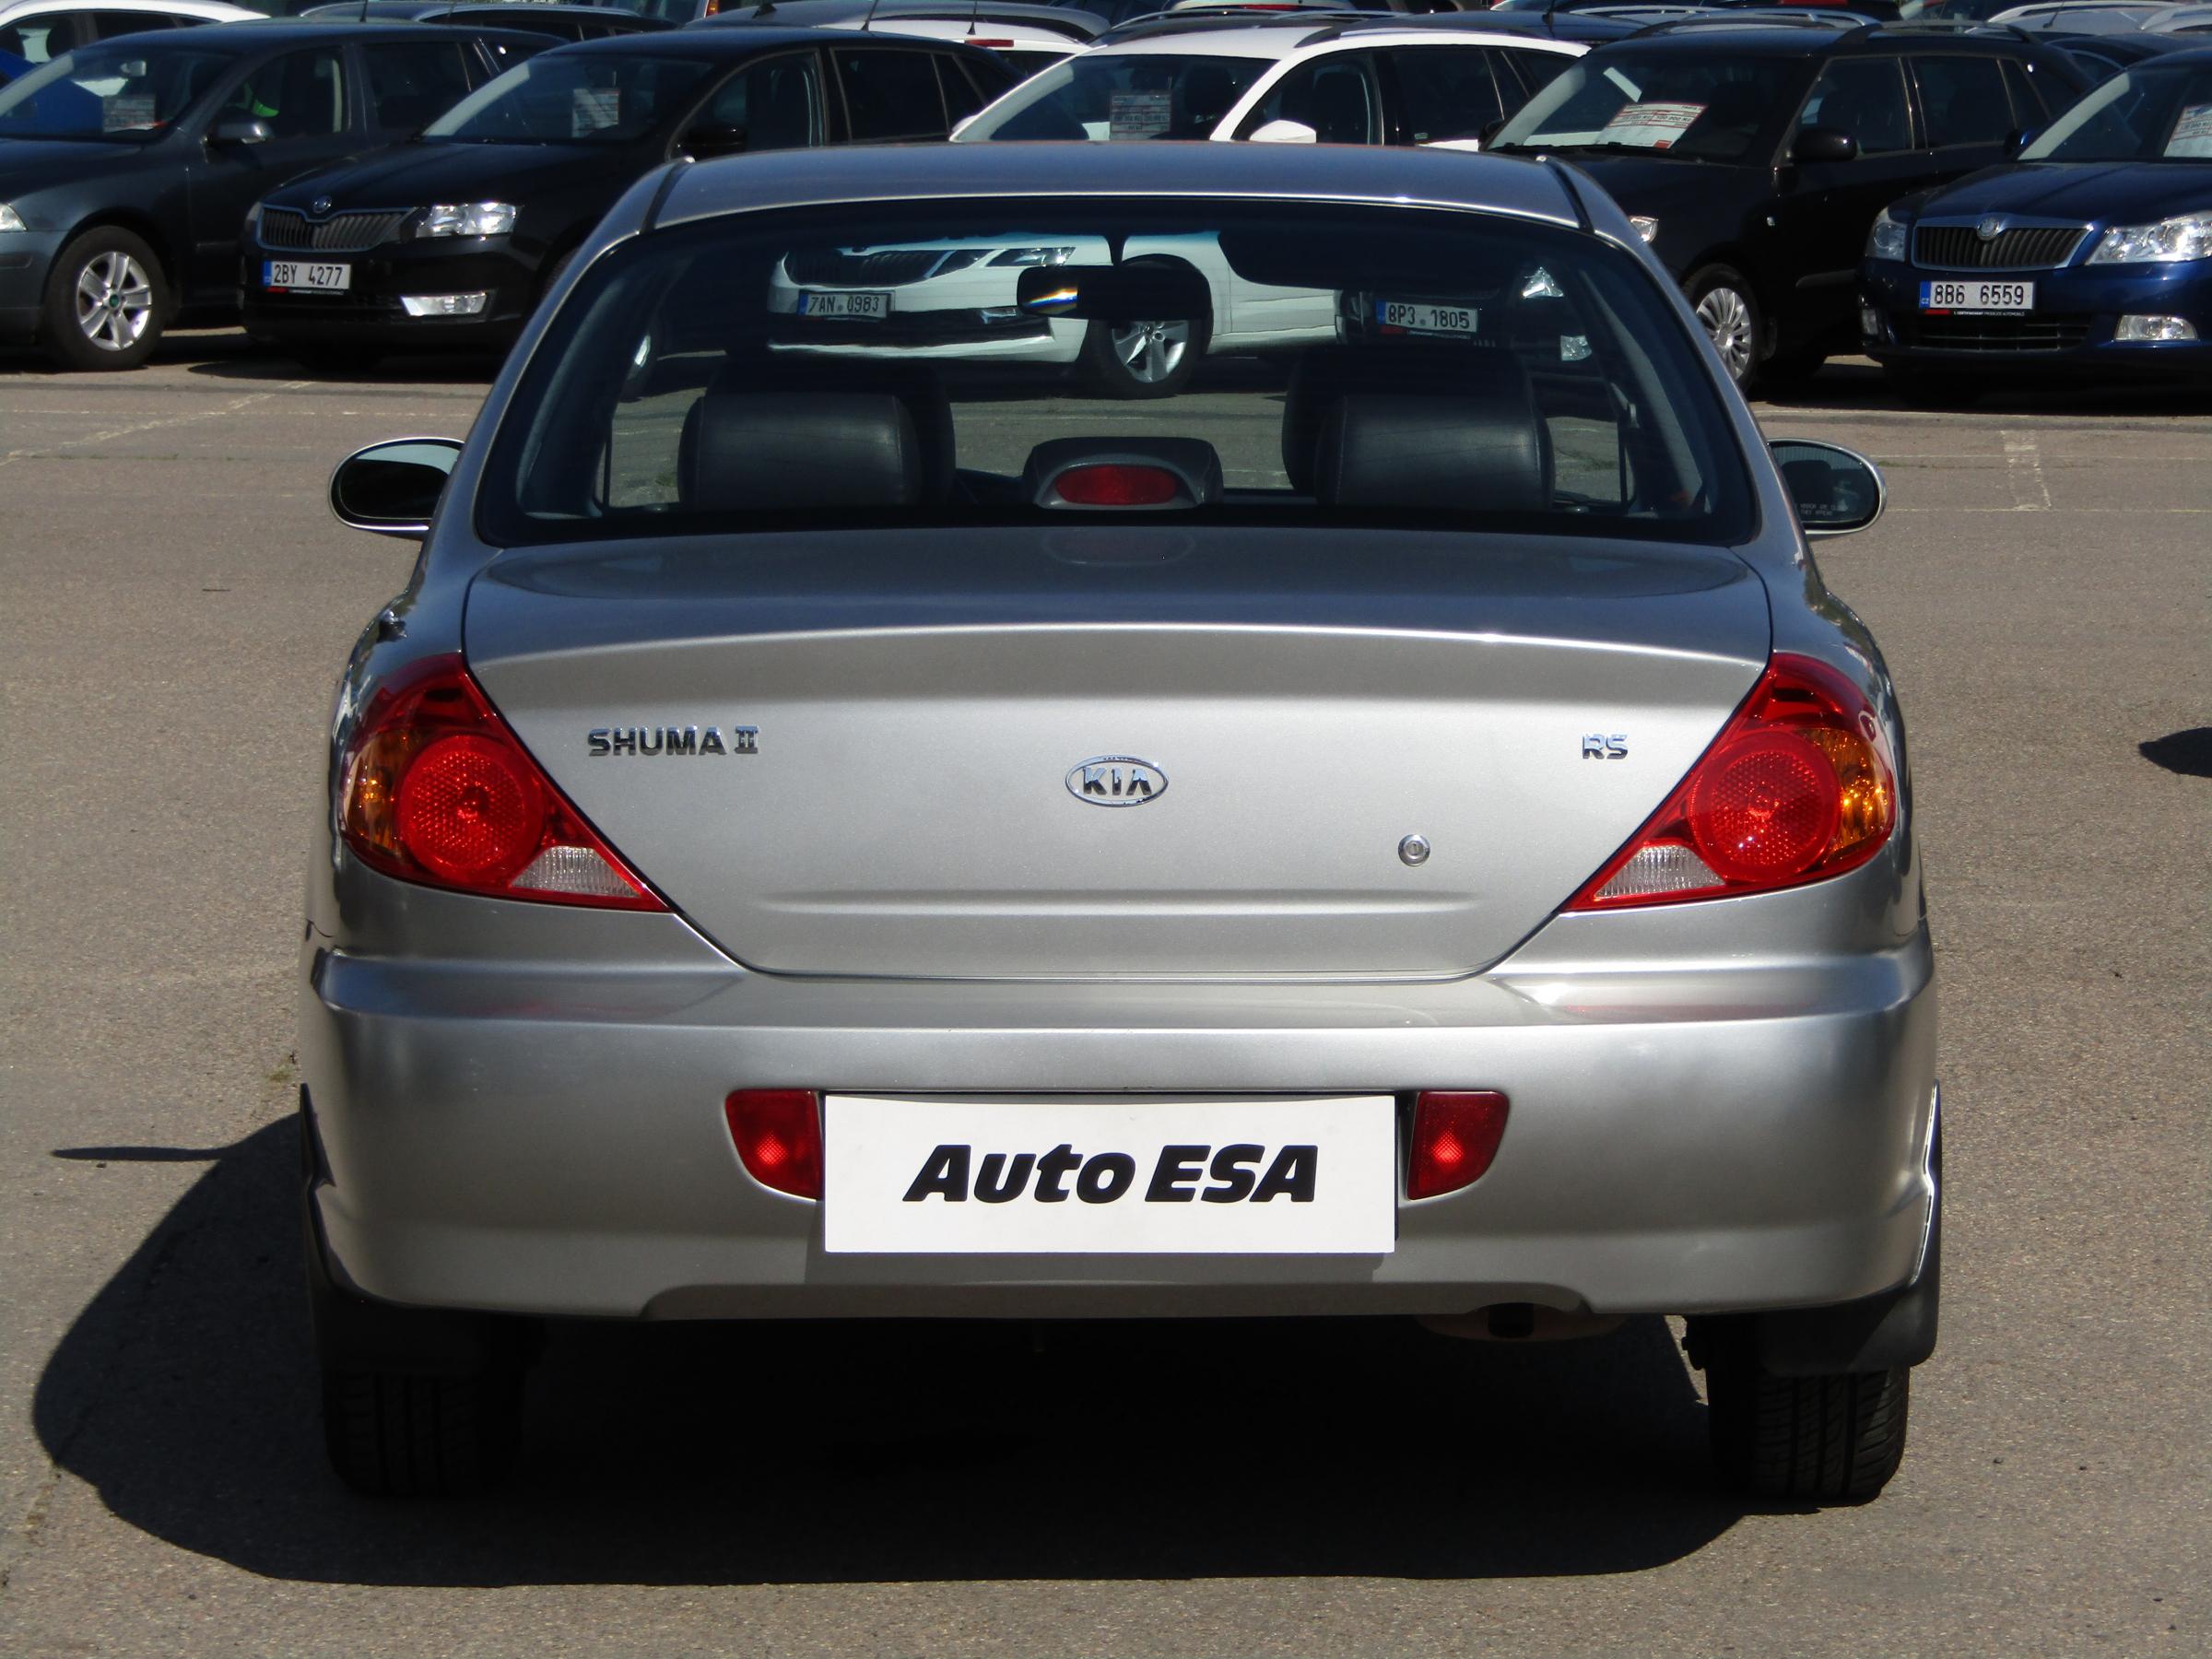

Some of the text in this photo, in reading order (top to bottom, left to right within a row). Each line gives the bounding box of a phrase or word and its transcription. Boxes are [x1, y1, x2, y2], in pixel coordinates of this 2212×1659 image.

[274, 265, 342, 286] 2BY 4277
[808, 296, 879, 313] 7AN 0983
[1935, 285, 2024, 305] 8B6 6559
[1389, 304, 1470, 329] 8P3 1805
[587, 725, 759, 757] SHUMA II
[1582, 734, 1629, 759] RS
[1082, 767, 1152, 795] KIA
[902, 1144, 1319, 1204] Auto ESA
